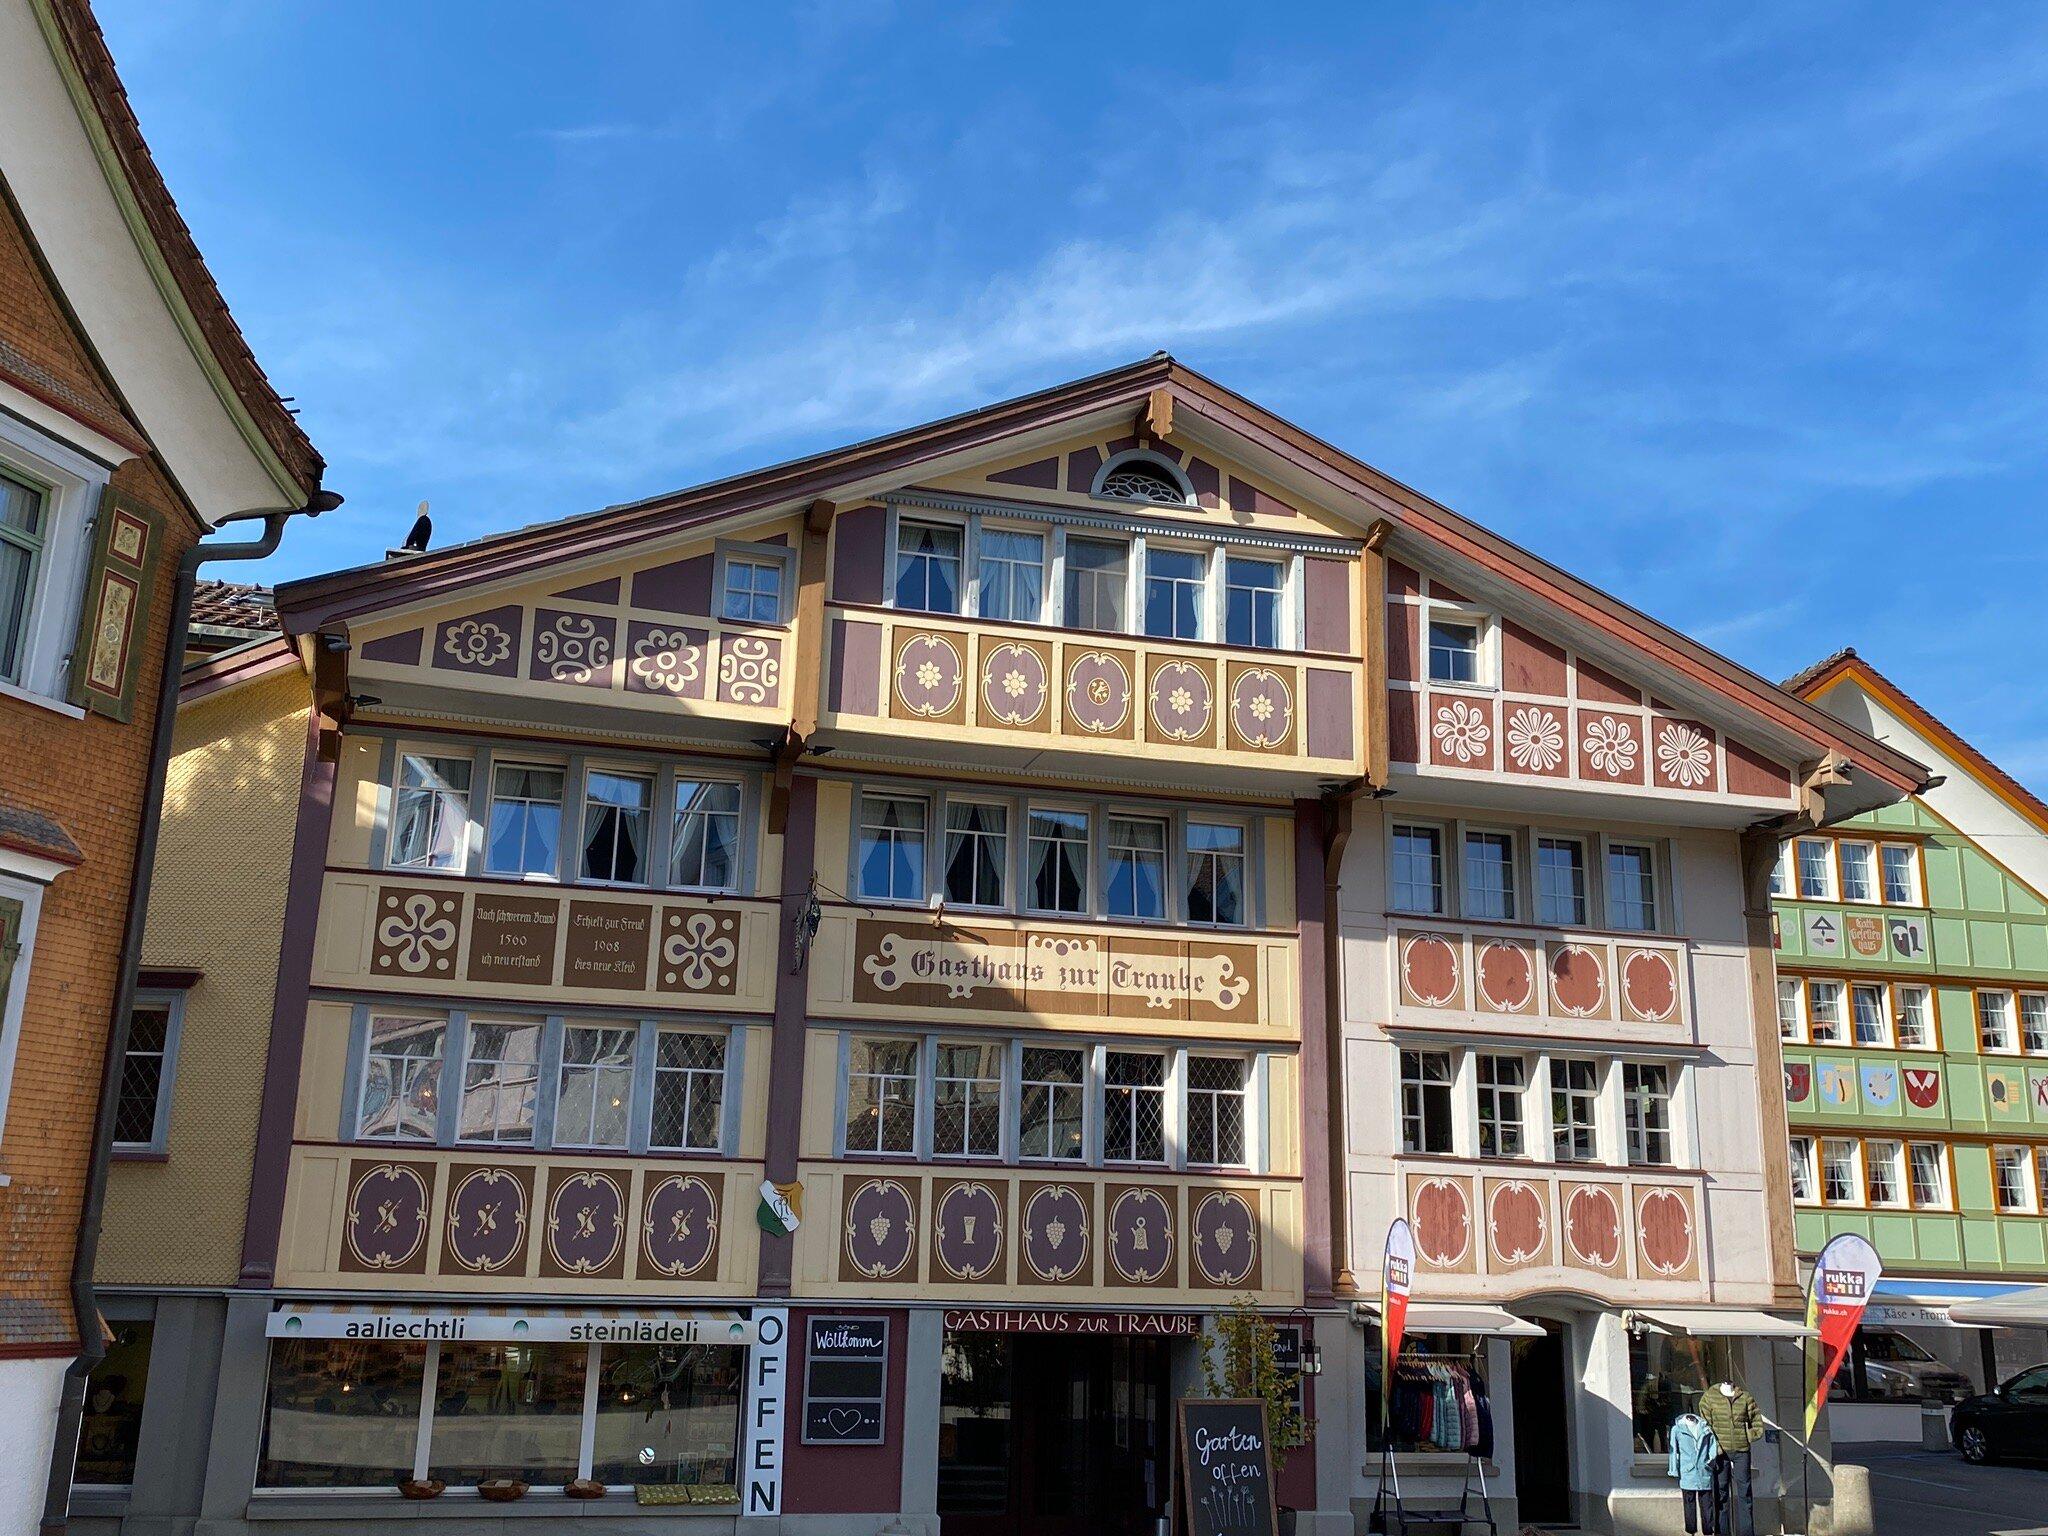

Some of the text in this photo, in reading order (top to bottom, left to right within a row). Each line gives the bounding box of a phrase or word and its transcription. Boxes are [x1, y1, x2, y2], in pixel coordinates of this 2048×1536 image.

[500, 933, 528, 946] 1560
[911, 949, 1206, 994] Gasthaus zur Traube
[1825, 1271, 1864, 1285] rukka
[943, 1310, 1069, 1331] GASTHAUS
[1114, 1313, 1197, 1335] TRAUBE
[1883, 1307, 1907, 1320] Käse
[345, 1316, 465, 1339] aaliechtli
[569, 1319, 699, 1342] steinlädeli
[749, 1314, 784, 1513] OFFEN
[1195, 1425, 1262, 1466] Garten
[1212, 1462, 1261, 1487] offen
